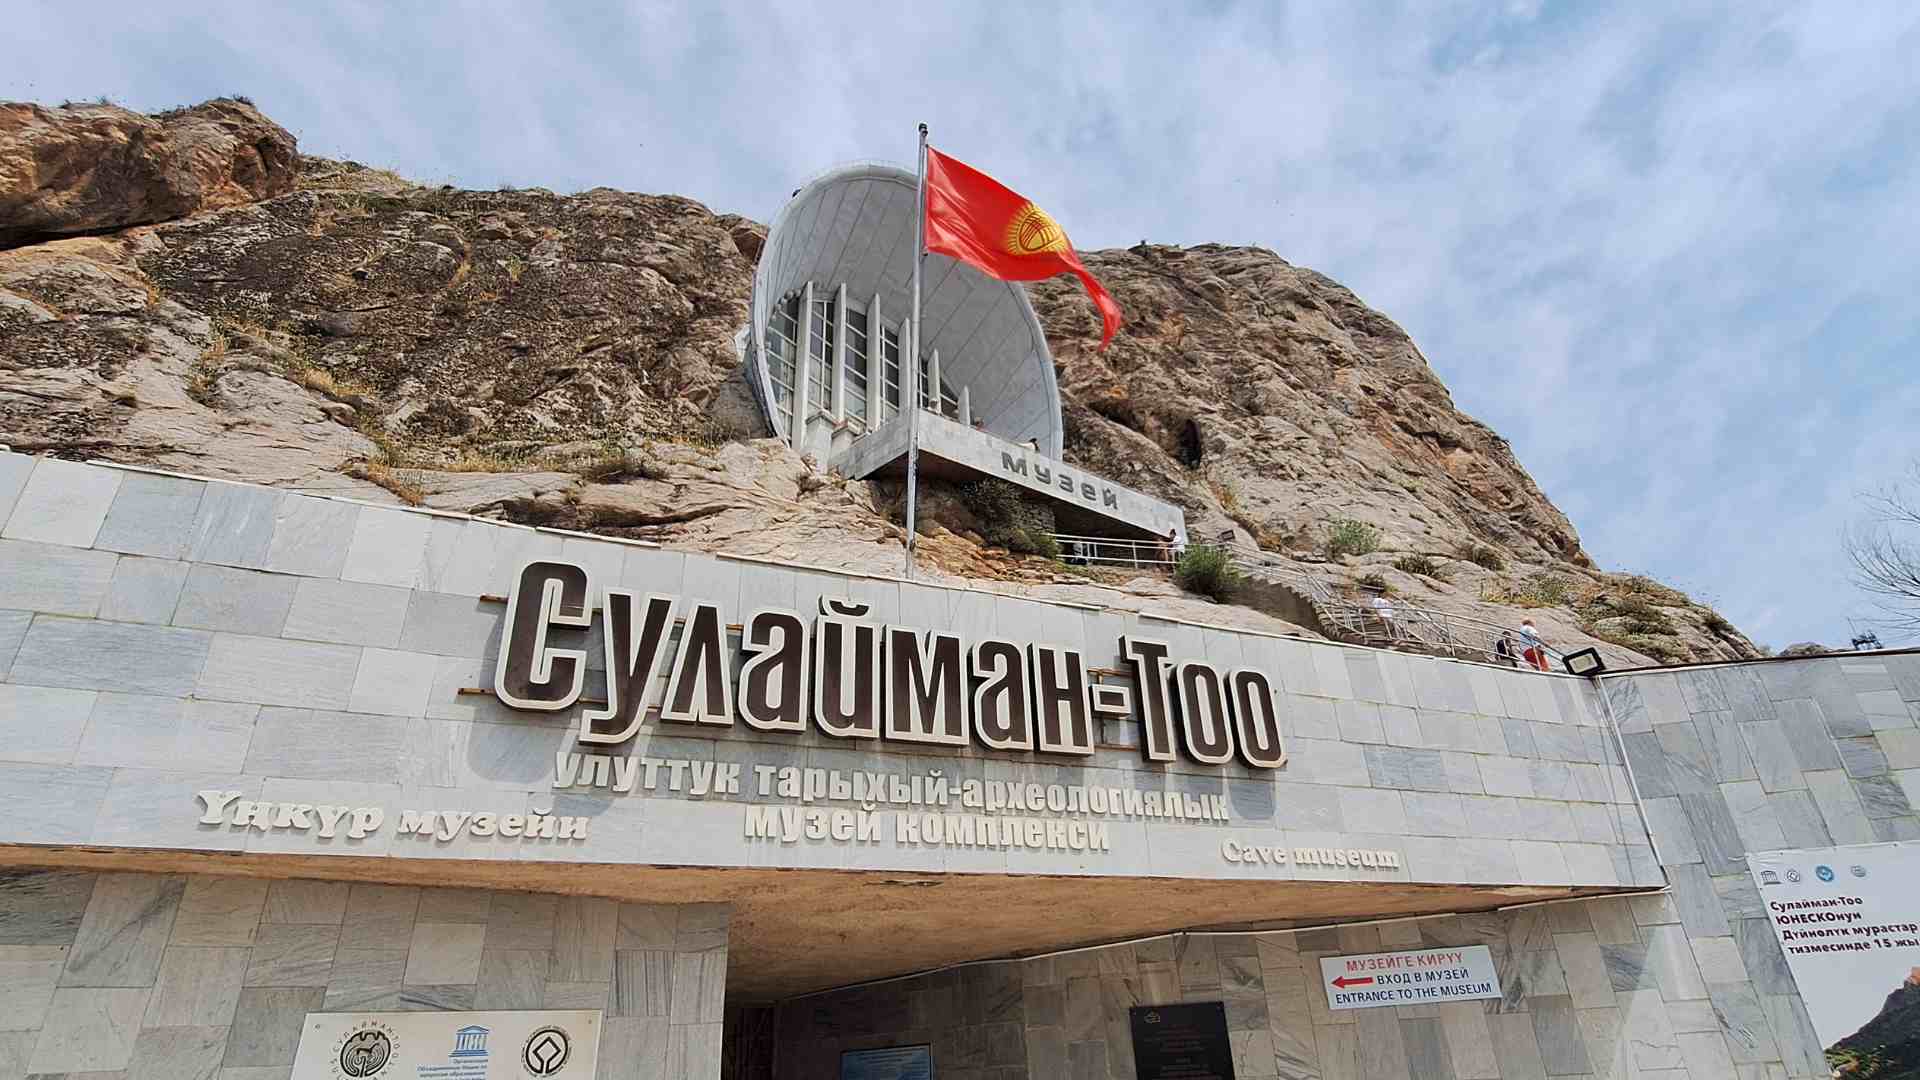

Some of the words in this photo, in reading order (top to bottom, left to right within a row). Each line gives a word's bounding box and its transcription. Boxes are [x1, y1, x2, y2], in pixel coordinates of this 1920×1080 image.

[494, 560, 1288, 769] Сулайман-Тоо
[896, 811, 1109, 851] комплекси
[1221, 839, 1288, 864] Cave
[1295, 848, 1400, 869] museum
[1852, 923, 1918, 937] мурастар
[1788, 941, 1871, 954] тизмесинде
[1873, 938, 1892, 949] 15
[1894, 938, 1920, 948] жы
[1346, 955, 1415, 972] МУЗЕЙГЕ
[1377, 972, 1412, 985] ВХОД
[1414, 972, 1422, 983] В
[1425, 967, 1470, 982] МУЗЕЙ
[1335, 989, 1394, 1004] ENTRANCE
[1396, 988, 1413, 1000] TO
[1414, 986, 1439, 999] THE
[1440, 983, 1493, 997] MUSEUM
